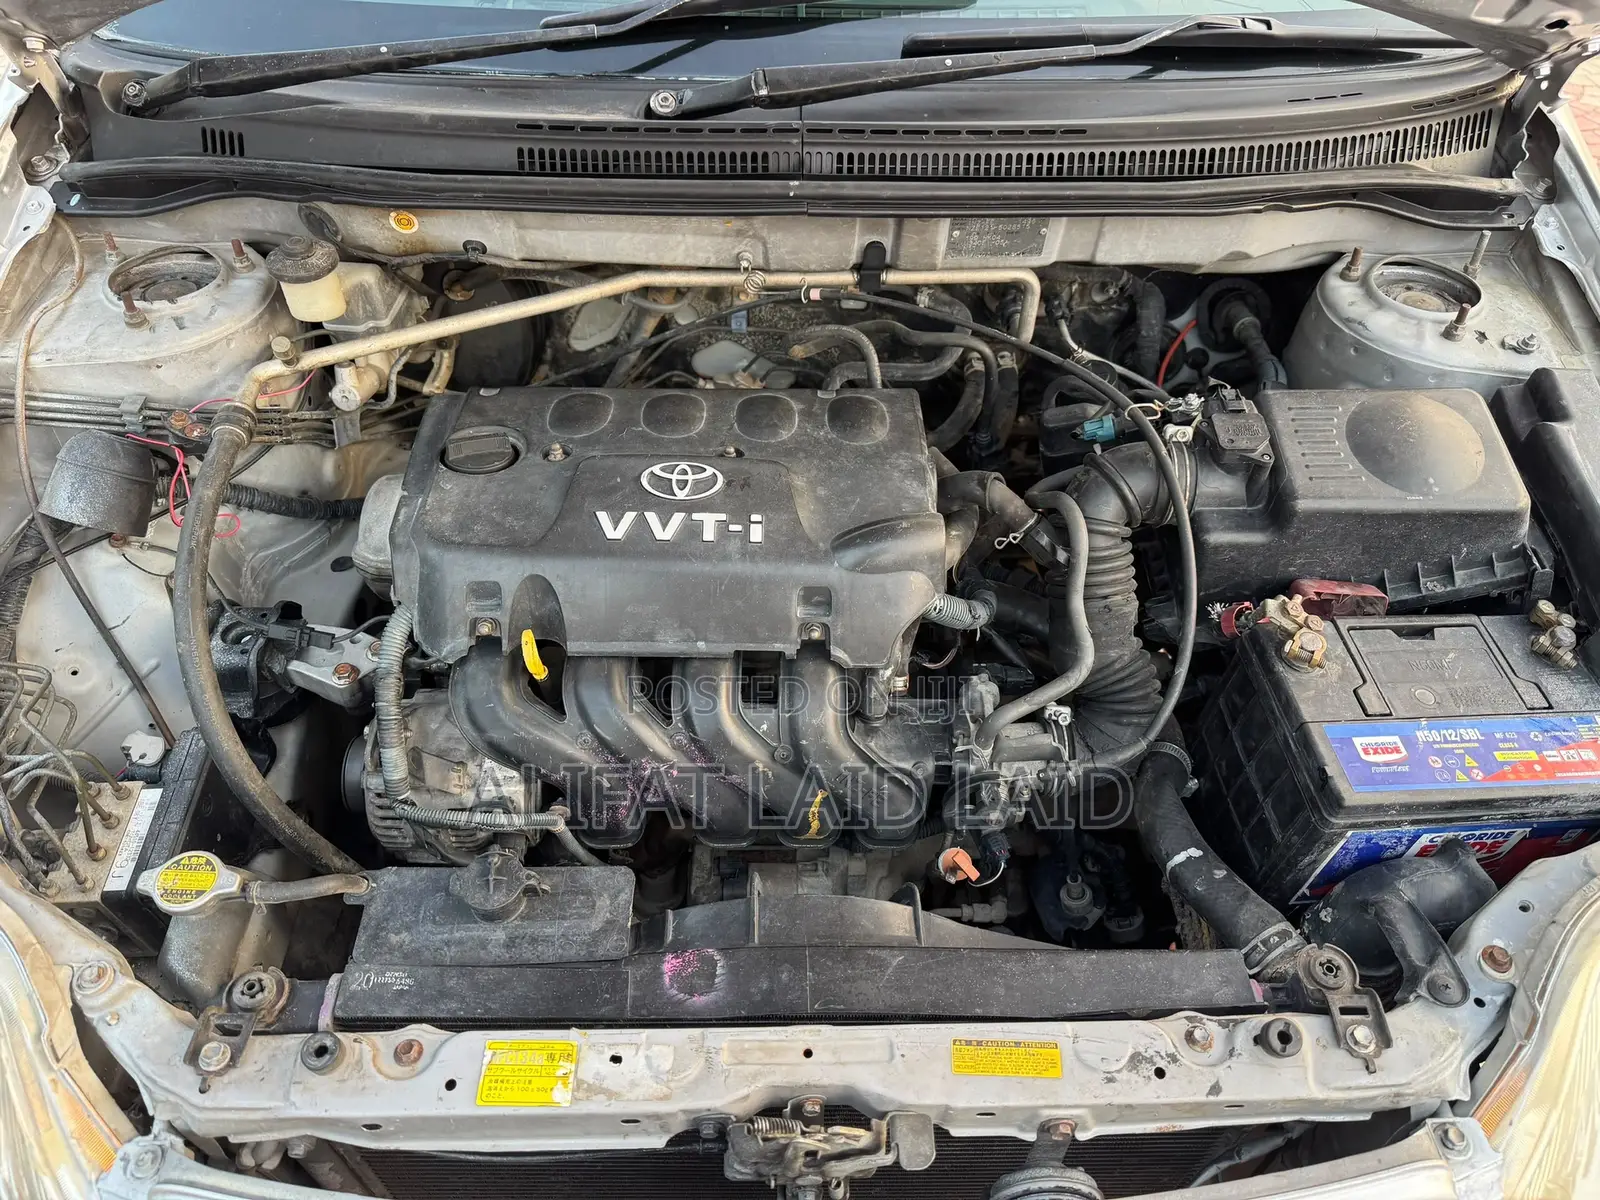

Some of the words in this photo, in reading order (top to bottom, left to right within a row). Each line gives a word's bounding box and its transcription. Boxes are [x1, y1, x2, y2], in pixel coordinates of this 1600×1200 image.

[595, 511, 763, 543] VVT-i
[1415, 728, 1485, 742] N50/12/SBL
[1361, 746, 1403, 756] EXIDE
[1428, 831, 1518, 843] CORIDE
[1415, 840, 1509, 857] EDE
[170, 863, 213, 871] CAUTION
[982, 1040, 1016, 1048] CAUTION
